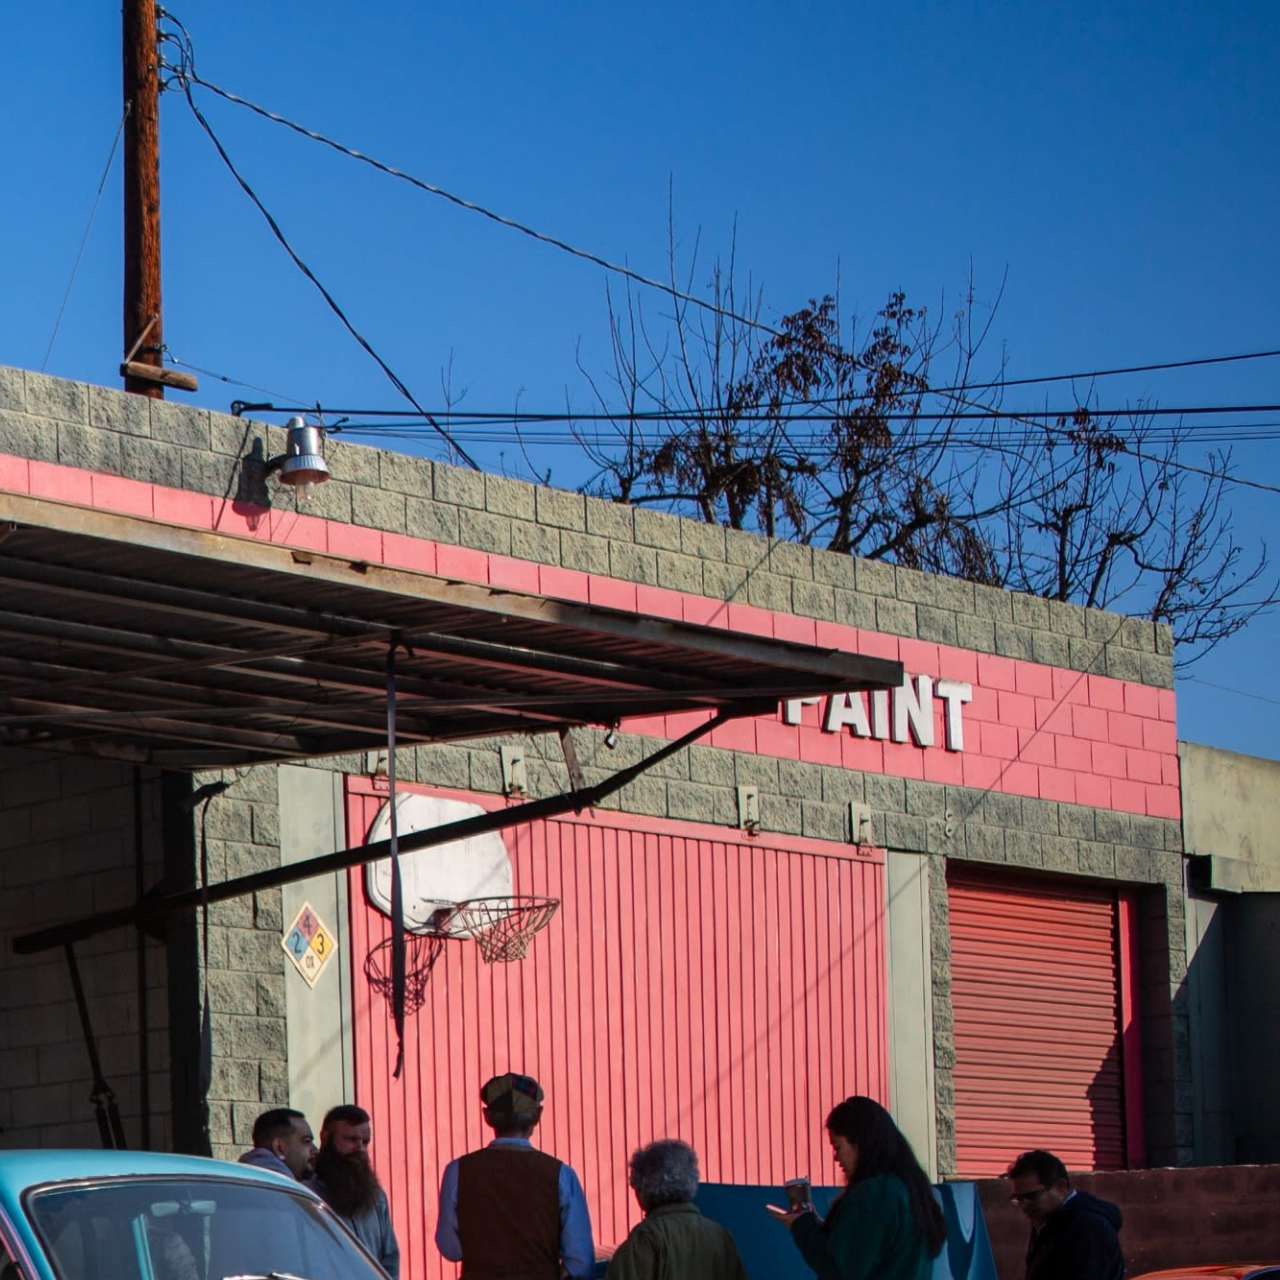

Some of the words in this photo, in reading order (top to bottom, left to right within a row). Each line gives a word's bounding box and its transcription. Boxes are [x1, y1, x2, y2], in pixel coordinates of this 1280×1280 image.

[303, 914, 312, 937] 4
[292, 931, 302, 954] 2
[316, 933, 325, 955] 3
